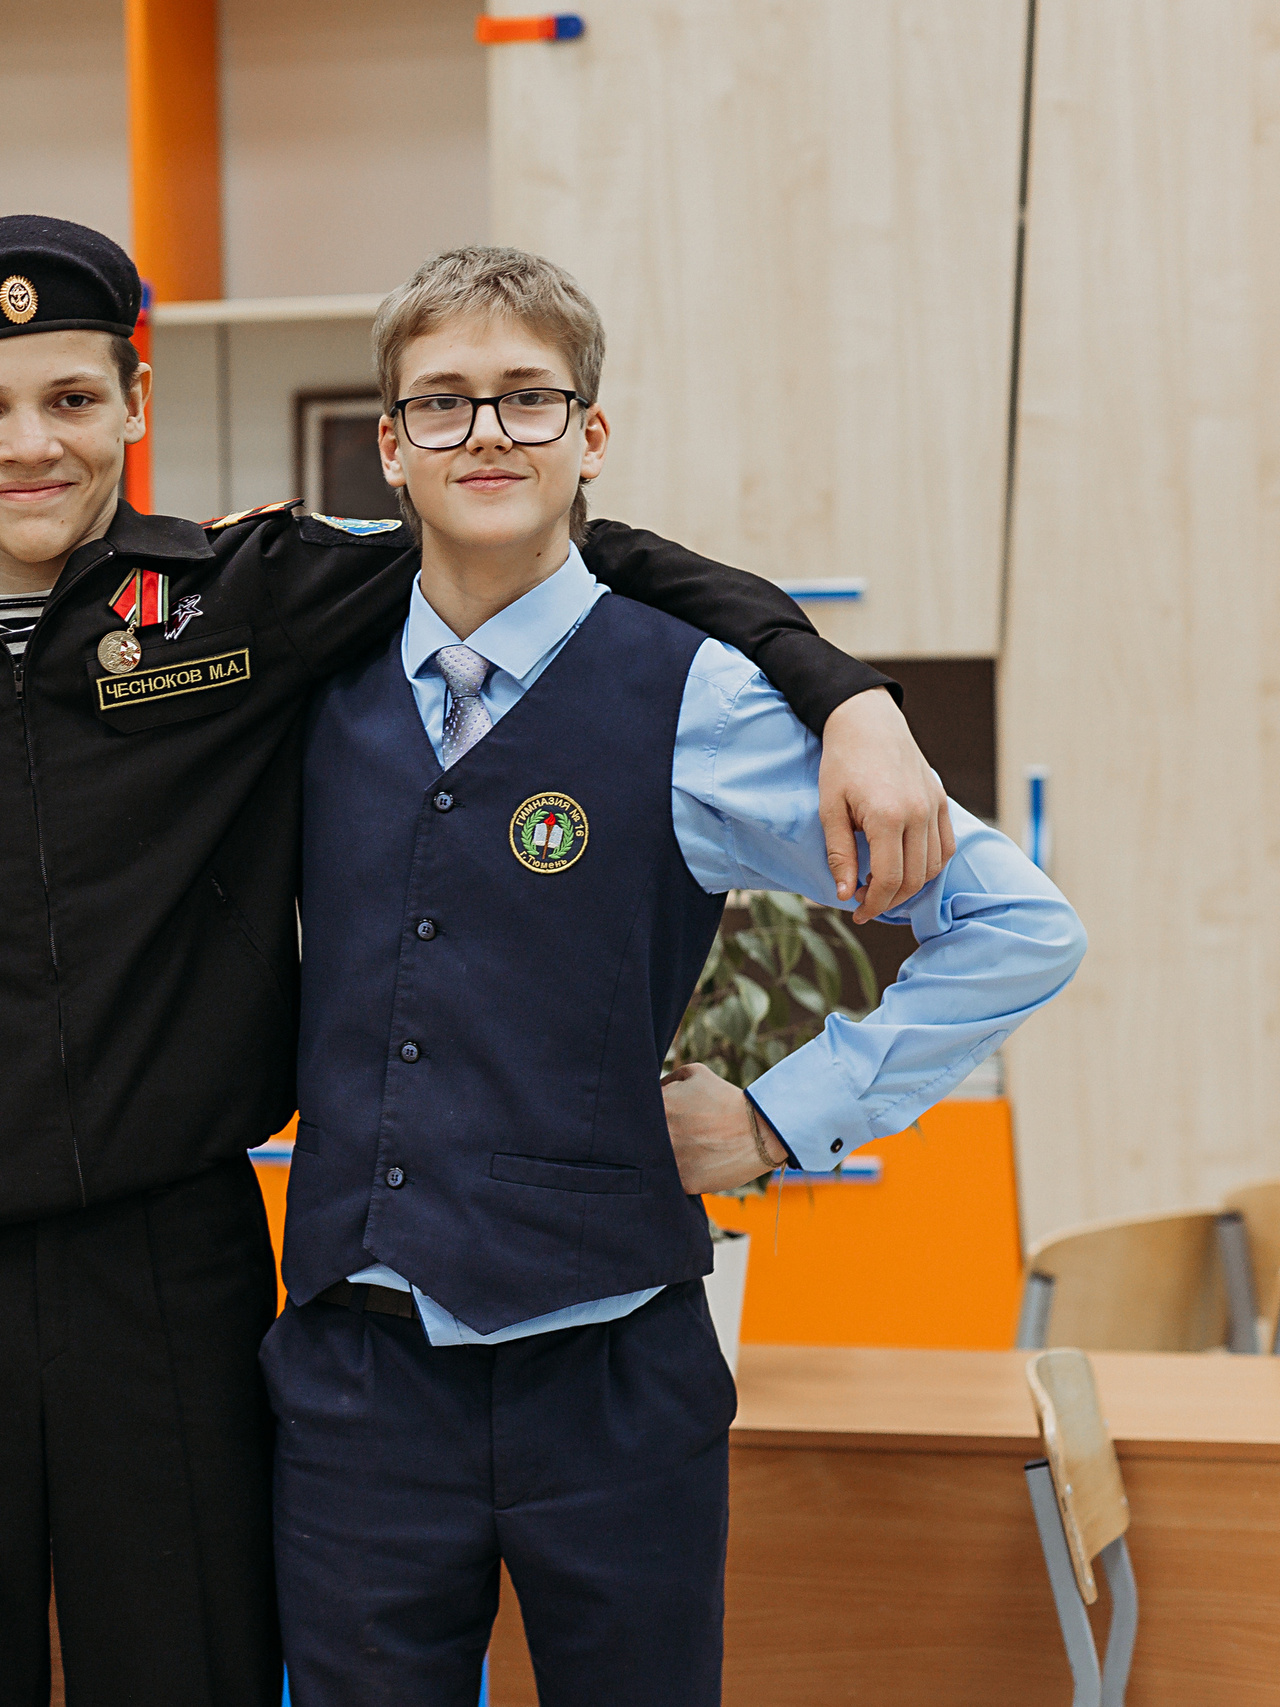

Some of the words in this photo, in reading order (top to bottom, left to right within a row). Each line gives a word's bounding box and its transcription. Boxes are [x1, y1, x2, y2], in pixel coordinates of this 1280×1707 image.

[106, 669, 203, 699] ЧЕСНОКОВ
[209, 660, 244, 680] М.А.
[515, 797, 571, 827] ГИМНАЗИЯ
